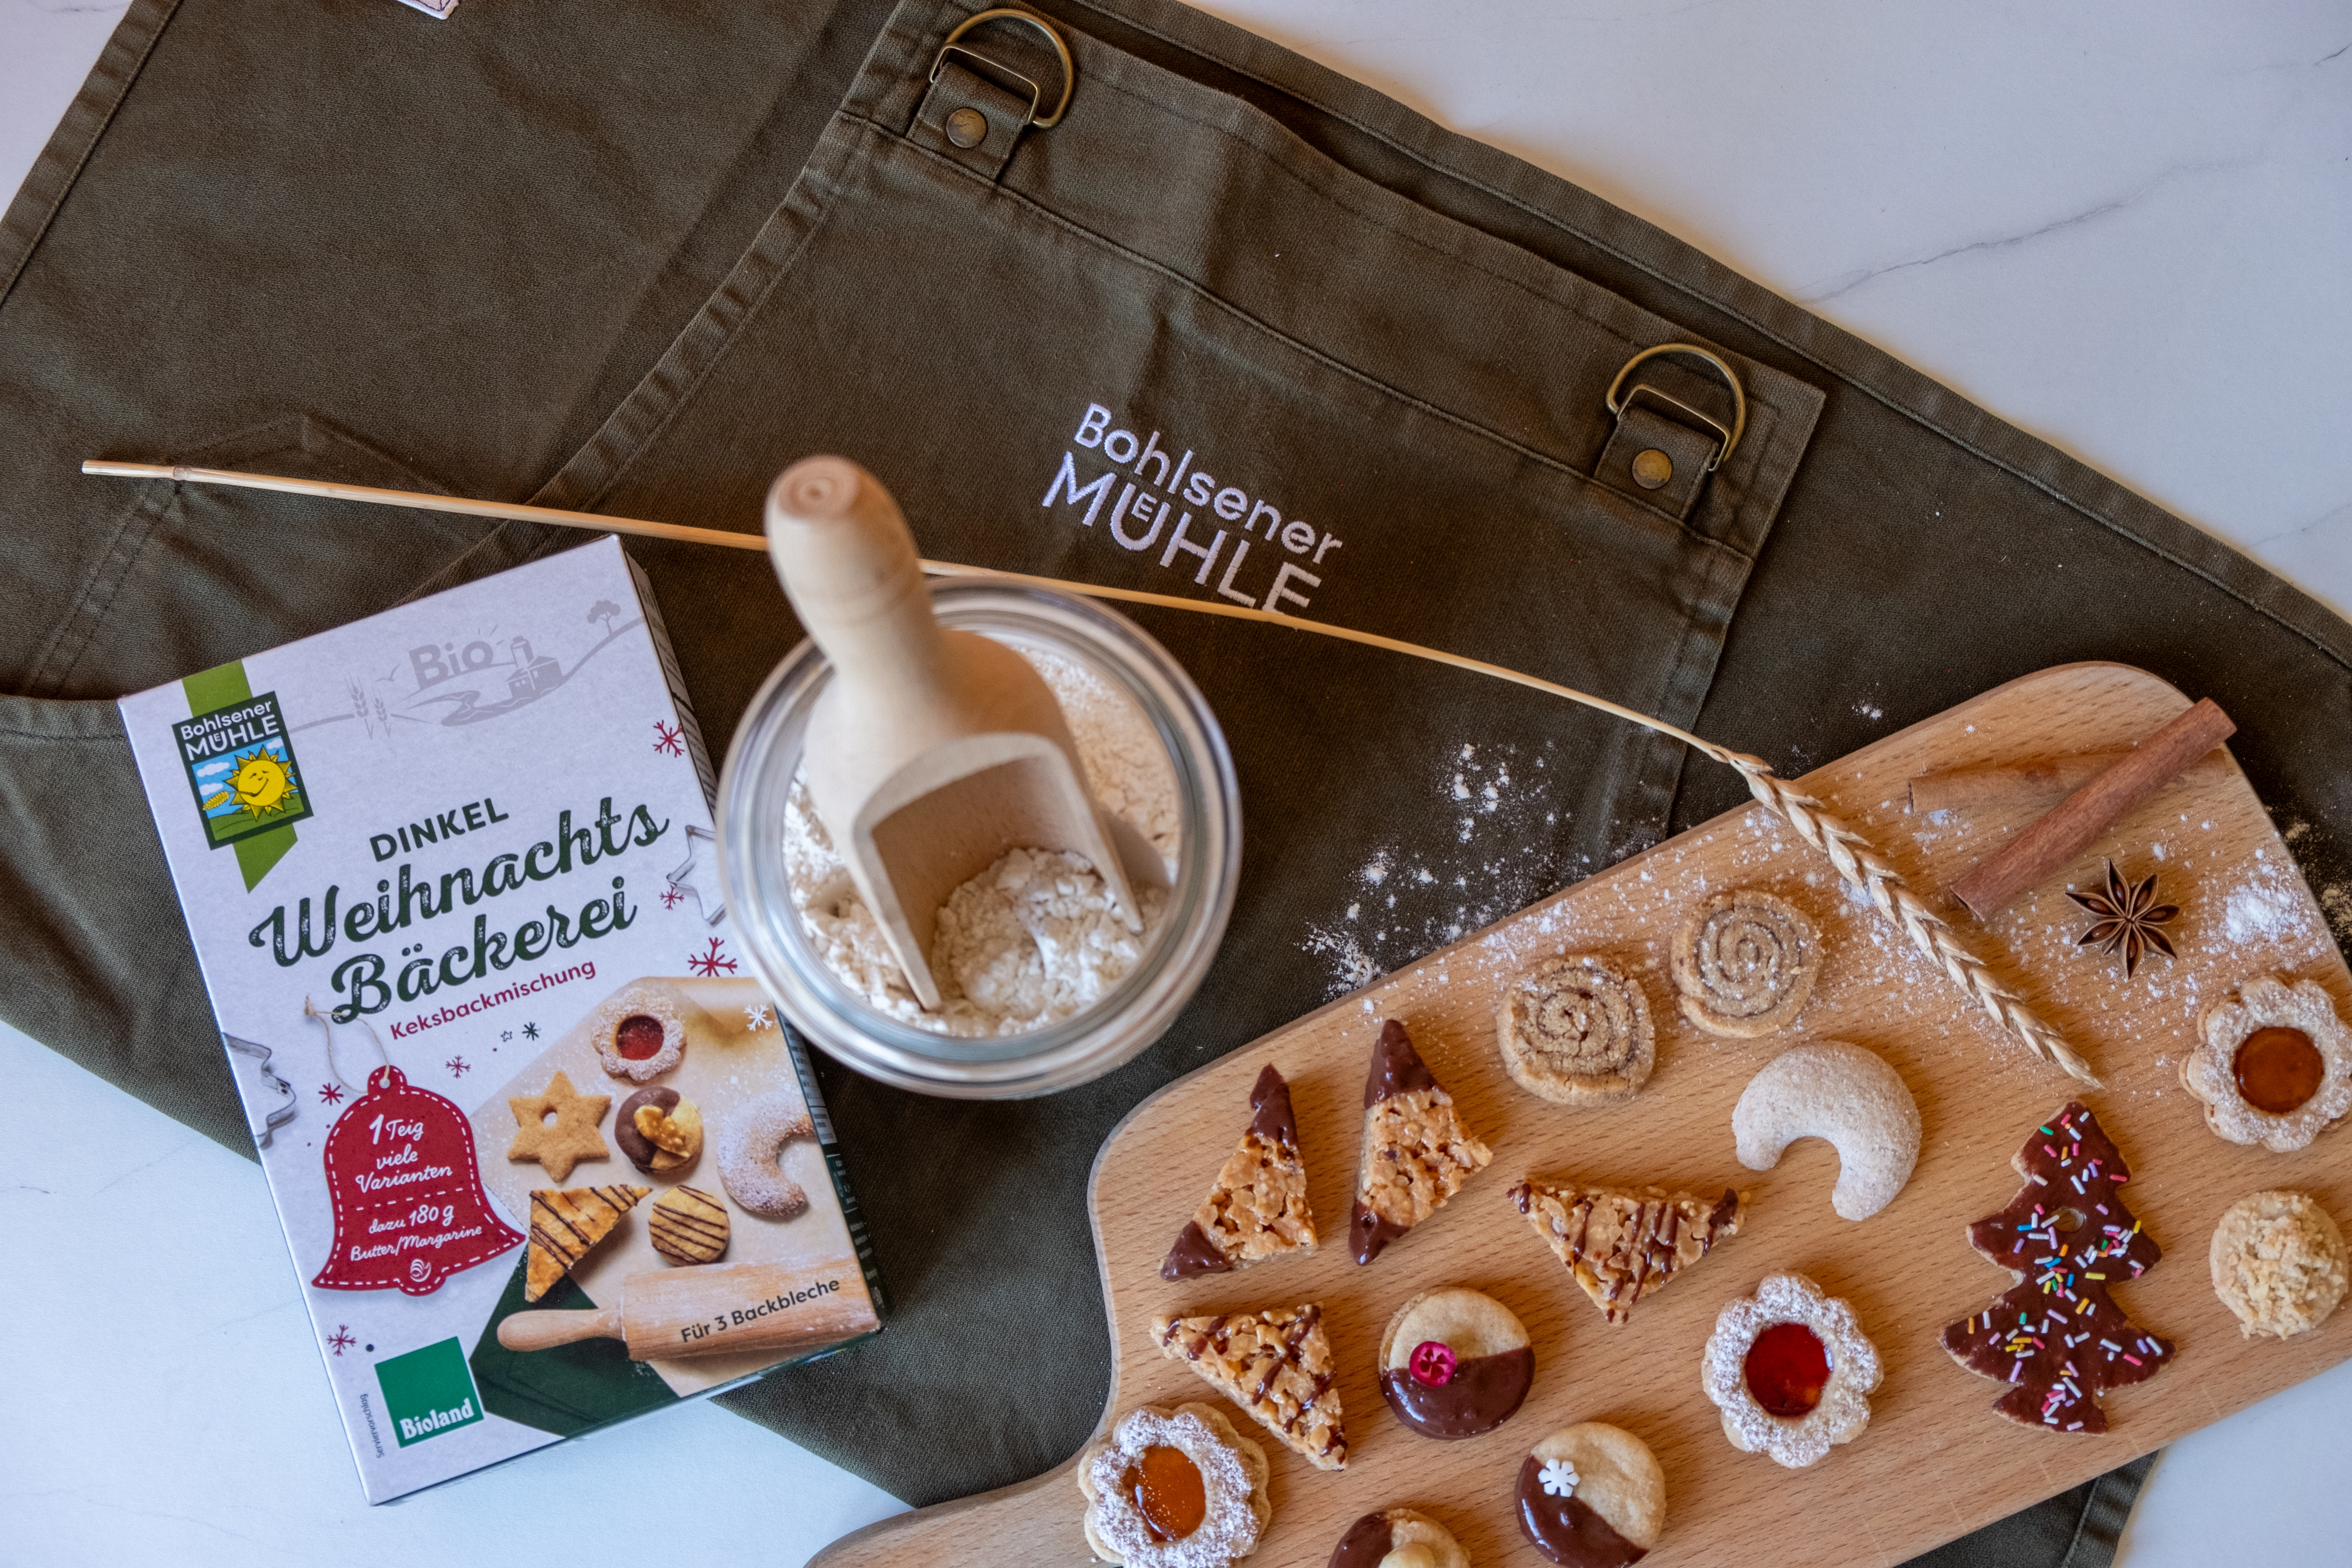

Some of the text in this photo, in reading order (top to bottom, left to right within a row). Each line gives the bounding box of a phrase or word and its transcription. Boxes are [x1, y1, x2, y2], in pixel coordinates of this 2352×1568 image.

[1074, 402, 1342, 564] Bohlsener
[408, 641, 494, 690] Bio
[180, 701, 271, 740] Bohlsener
[369, 798, 509, 862] DINKEL
[249, 797, 670, 967] Weihnachts
[331, 877, 637, 1024] Bäckerei
[390, 961, 596, 1040] Keksbackmischung
[369, 1114, 424, 1145] 1 Teig
[355, 1166, 453, 1193] Varianten
[376, 1143, 418, 1169] viele
[350, 1226, 482, 1261] Butter/Margarine
[368, 1204, 454, 1234] dazu 180 g
[680, 1279, 840, 1342] Für 3 Backbleche
[360, 1394, 384, 1458] Serviervorschlag
[399, 1397, 475, 1440] Bioland
